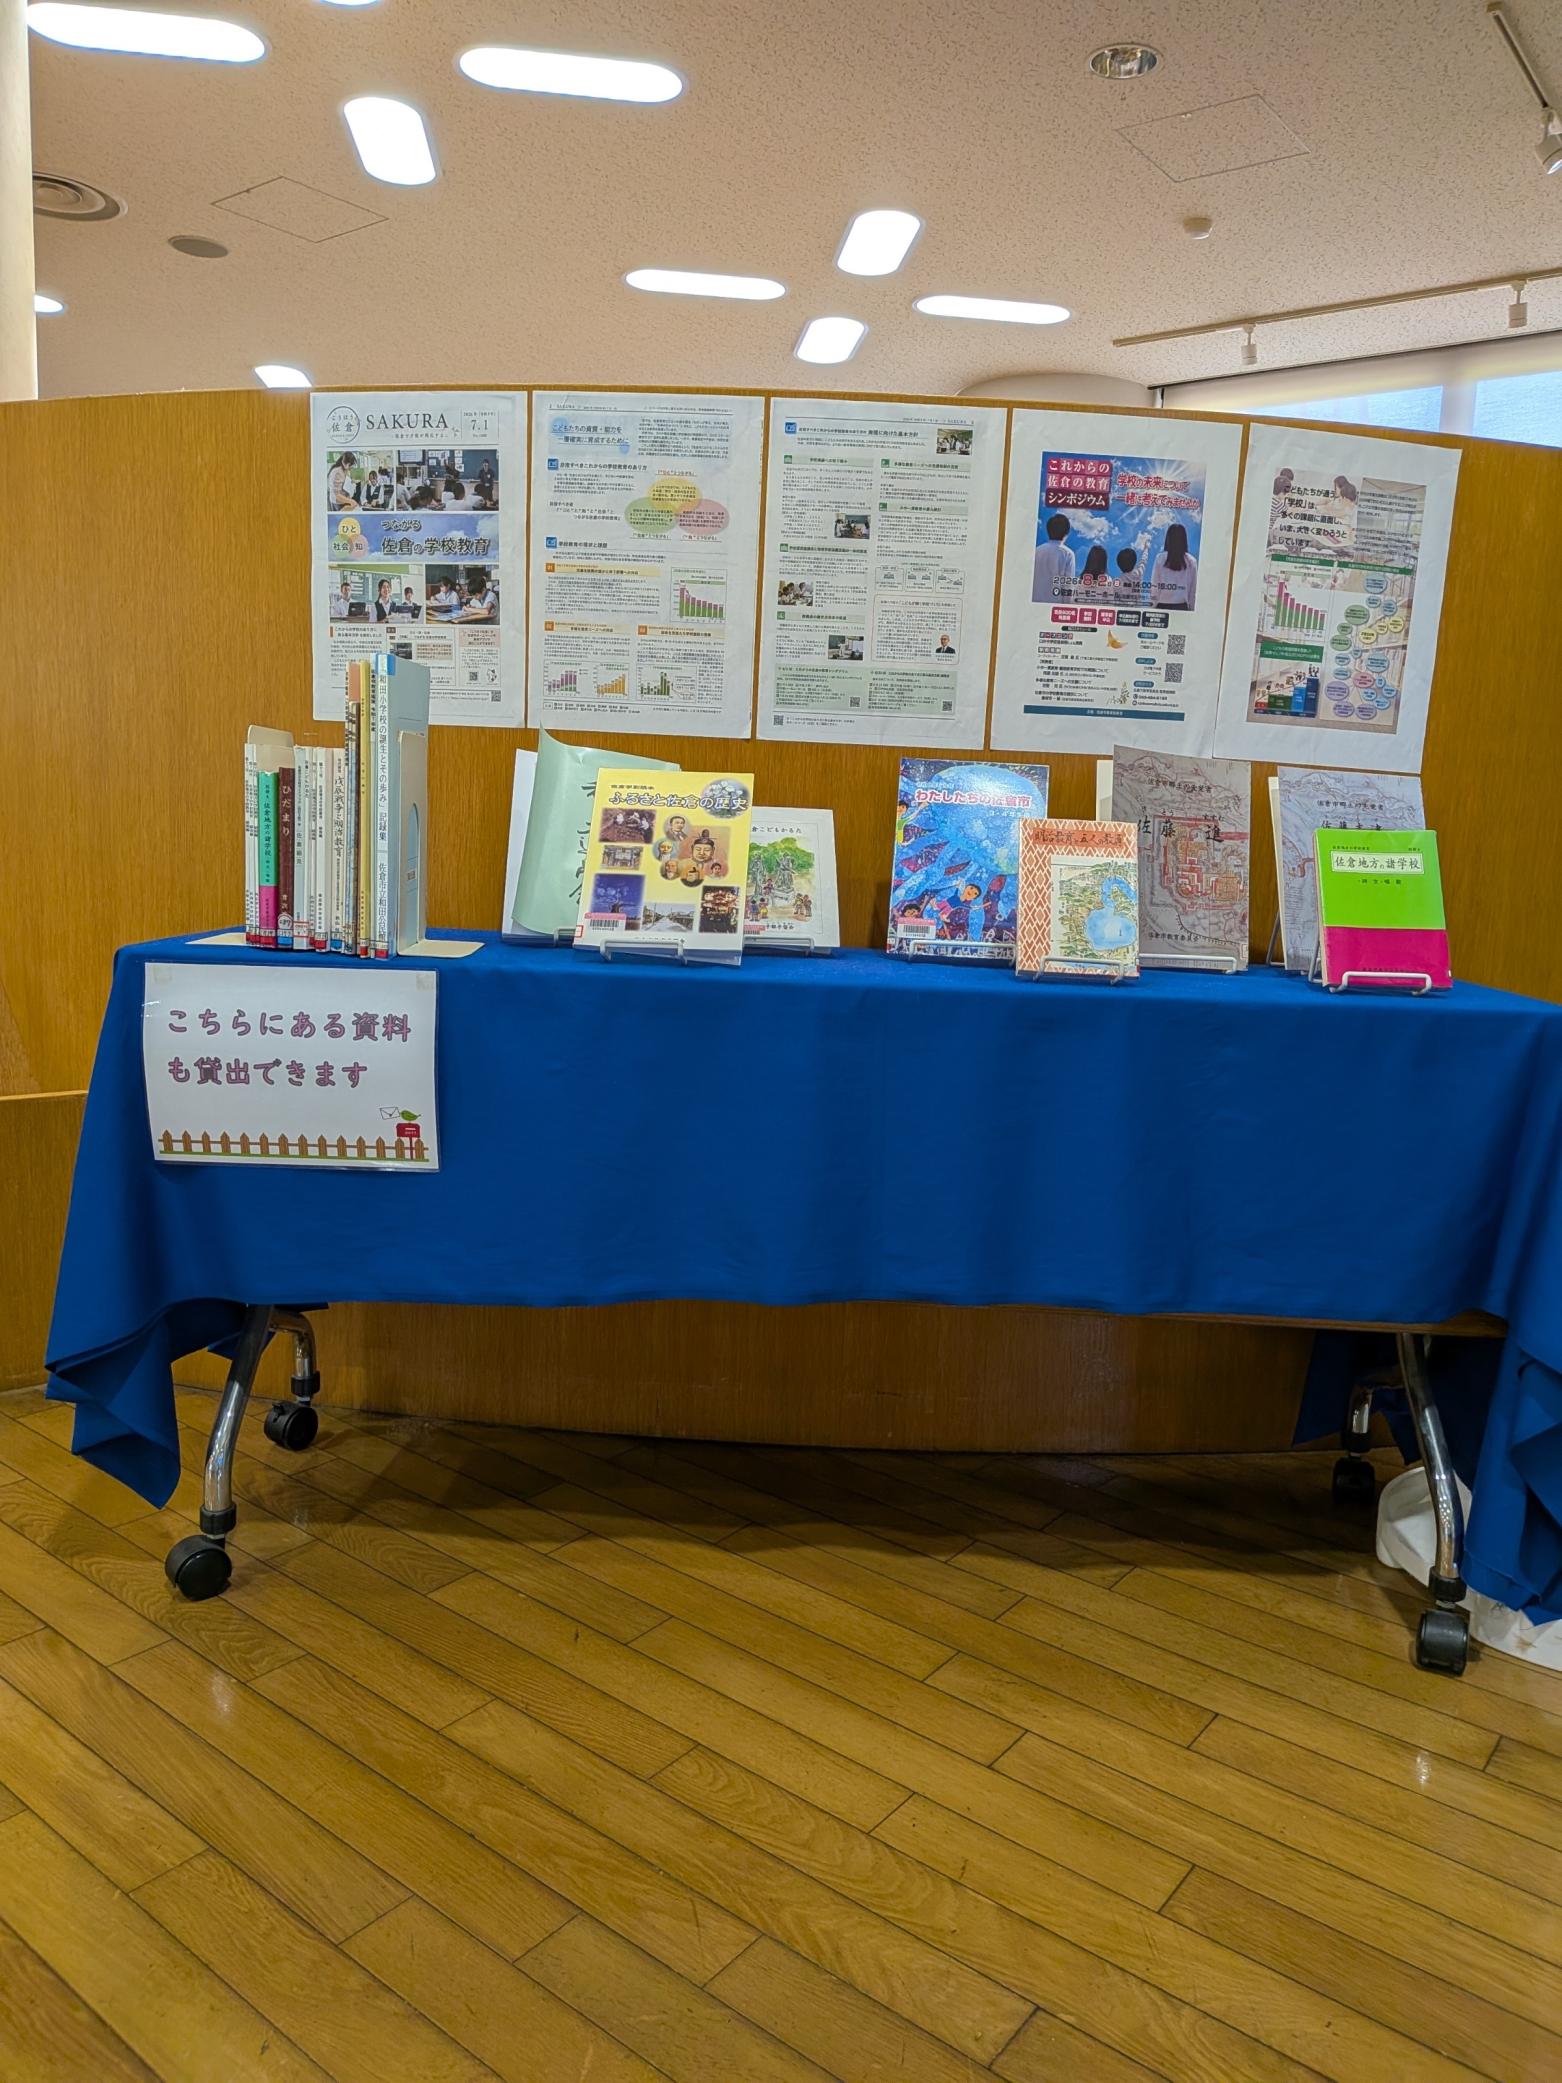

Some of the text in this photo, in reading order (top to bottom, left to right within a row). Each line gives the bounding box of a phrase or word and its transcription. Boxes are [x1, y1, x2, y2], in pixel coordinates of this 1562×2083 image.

[332, 422, 355, 433] 佐倉
[366, 413, 449, 430] SAKURA
[471, 419, 488, 431] 7.1
[1048, 460, 1110, 473] これからの
[1047, 475, 1109, 491] 佐倉の教育
[1117, 472, 1191, 491] 学校の未来について
[1047, 492, 1106, 506] シンポジウム
[341, 525, 357, 534] ひと
[381, 519, 423, 531] つながる
[333, 542, 350, 551] 社会
[354, 542, 364, 551] 知
[381, 536, 491, 556] 佐倉の学校教育
[609, 792, 749, 810] ふるさと佐倉の歴史
[915, 789, 1031, 808] わたしたちの佐倉市
[282, 785, 292, 837] ひだまり
[1335, 856, 1421, 870] 佐倉地方の諸学校
[168, 1008, 411, 1042] こちらにある資料
[168, 1056, 368, 1088] も貸出できます
